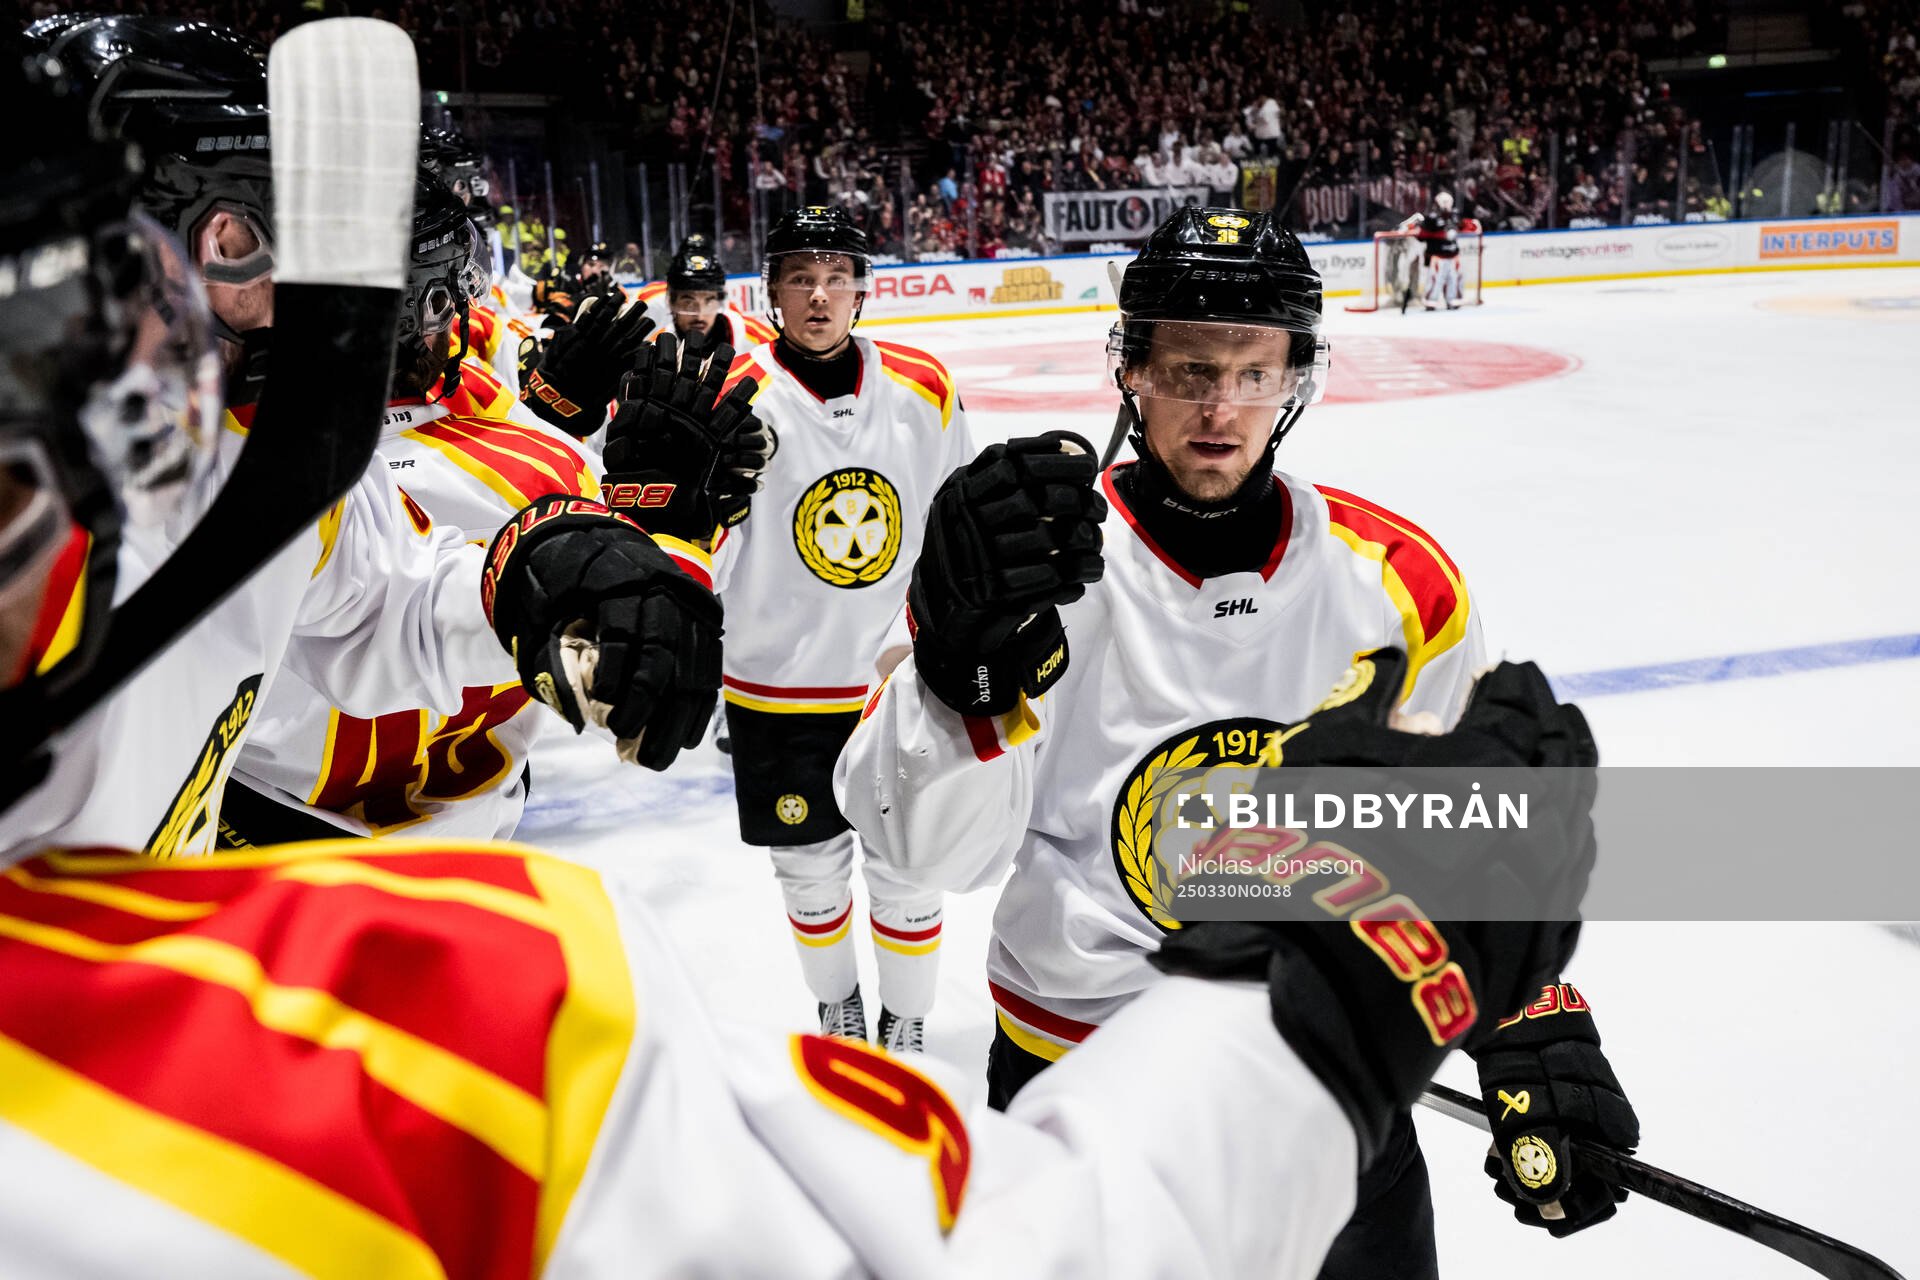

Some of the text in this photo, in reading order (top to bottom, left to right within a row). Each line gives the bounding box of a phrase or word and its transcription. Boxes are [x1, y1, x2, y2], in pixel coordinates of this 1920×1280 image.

[1217, 229, 1239, 243] 36
[1762, 228, 1894, 252] INTERPUTS
[832, 408, 855, 418] SHL
[832, 472, 867, 489] 1912
[1213, 597, 1259, 619] SHL
[1036, 643, 1064, 683] MACH
[218, 689, 254, 749] 1912
